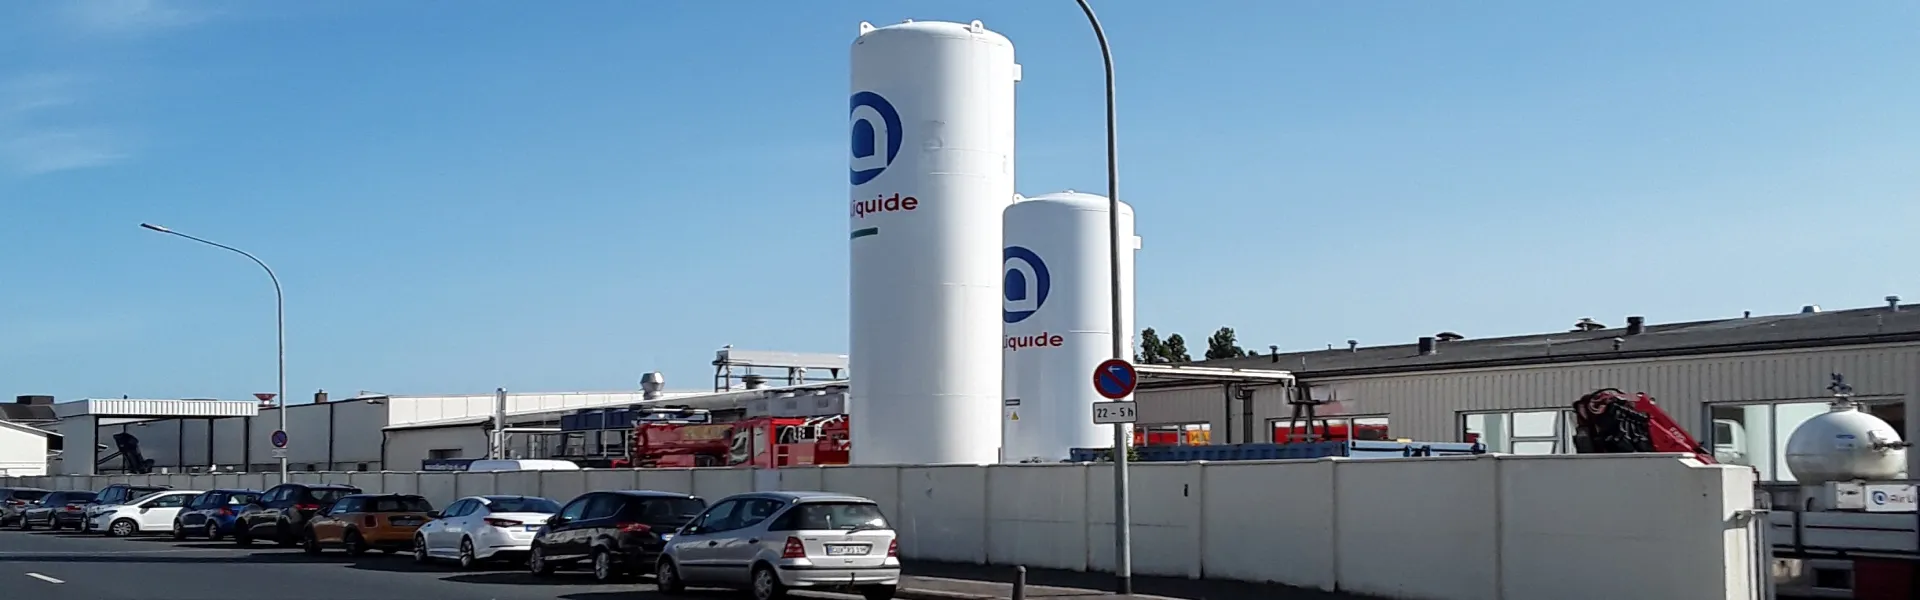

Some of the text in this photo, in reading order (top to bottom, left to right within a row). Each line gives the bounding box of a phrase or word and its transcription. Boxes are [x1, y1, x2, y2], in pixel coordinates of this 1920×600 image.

[1096, 408, 1108, 418] 22
[1120, 408, 1125, 417] 5
[1128, 406, 1134, 416] h
